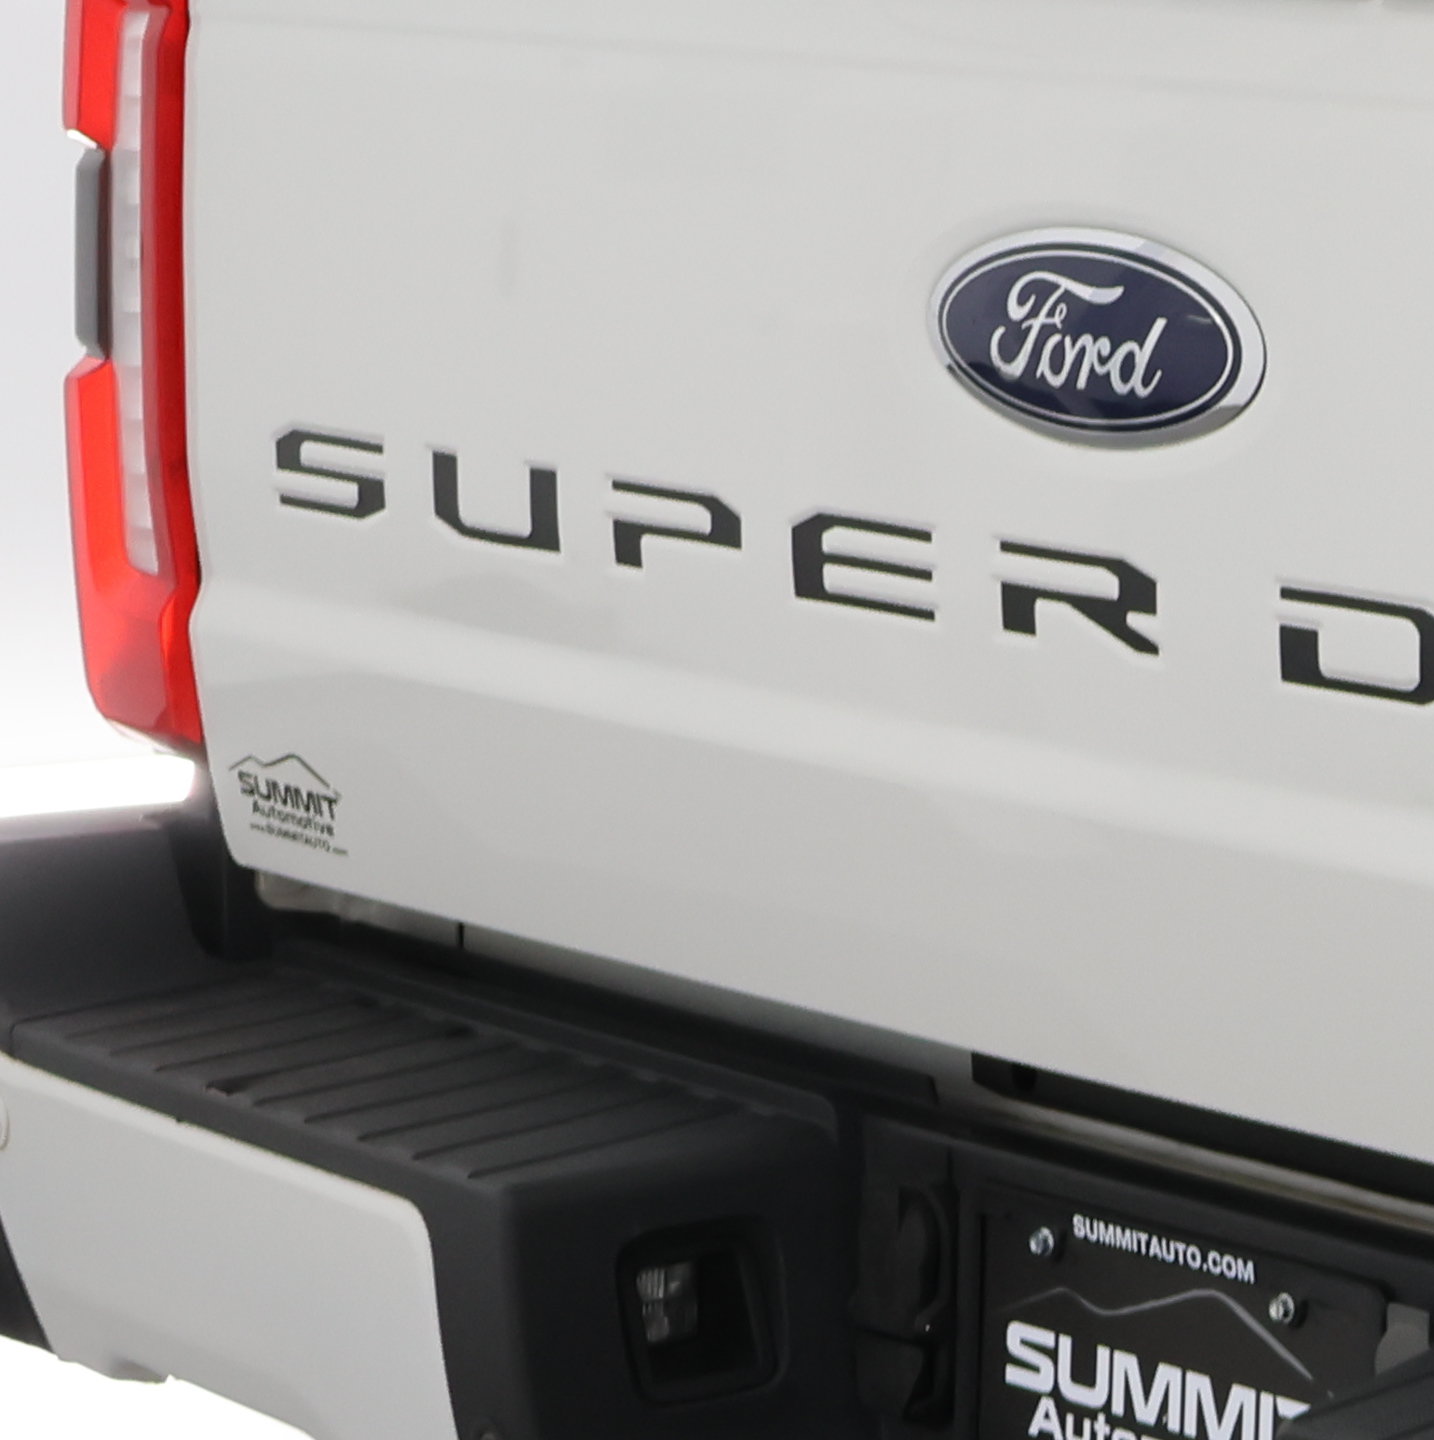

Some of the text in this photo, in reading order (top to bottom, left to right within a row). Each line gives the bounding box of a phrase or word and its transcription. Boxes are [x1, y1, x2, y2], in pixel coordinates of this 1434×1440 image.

[990, 270, 1168, 399] Ford
[275, 427, 1160, 657] SUPER
[238, 770, 338, 820] SUMMIT
[1072, 1214, 1256, 1284] SUMMITAUTO.COM
